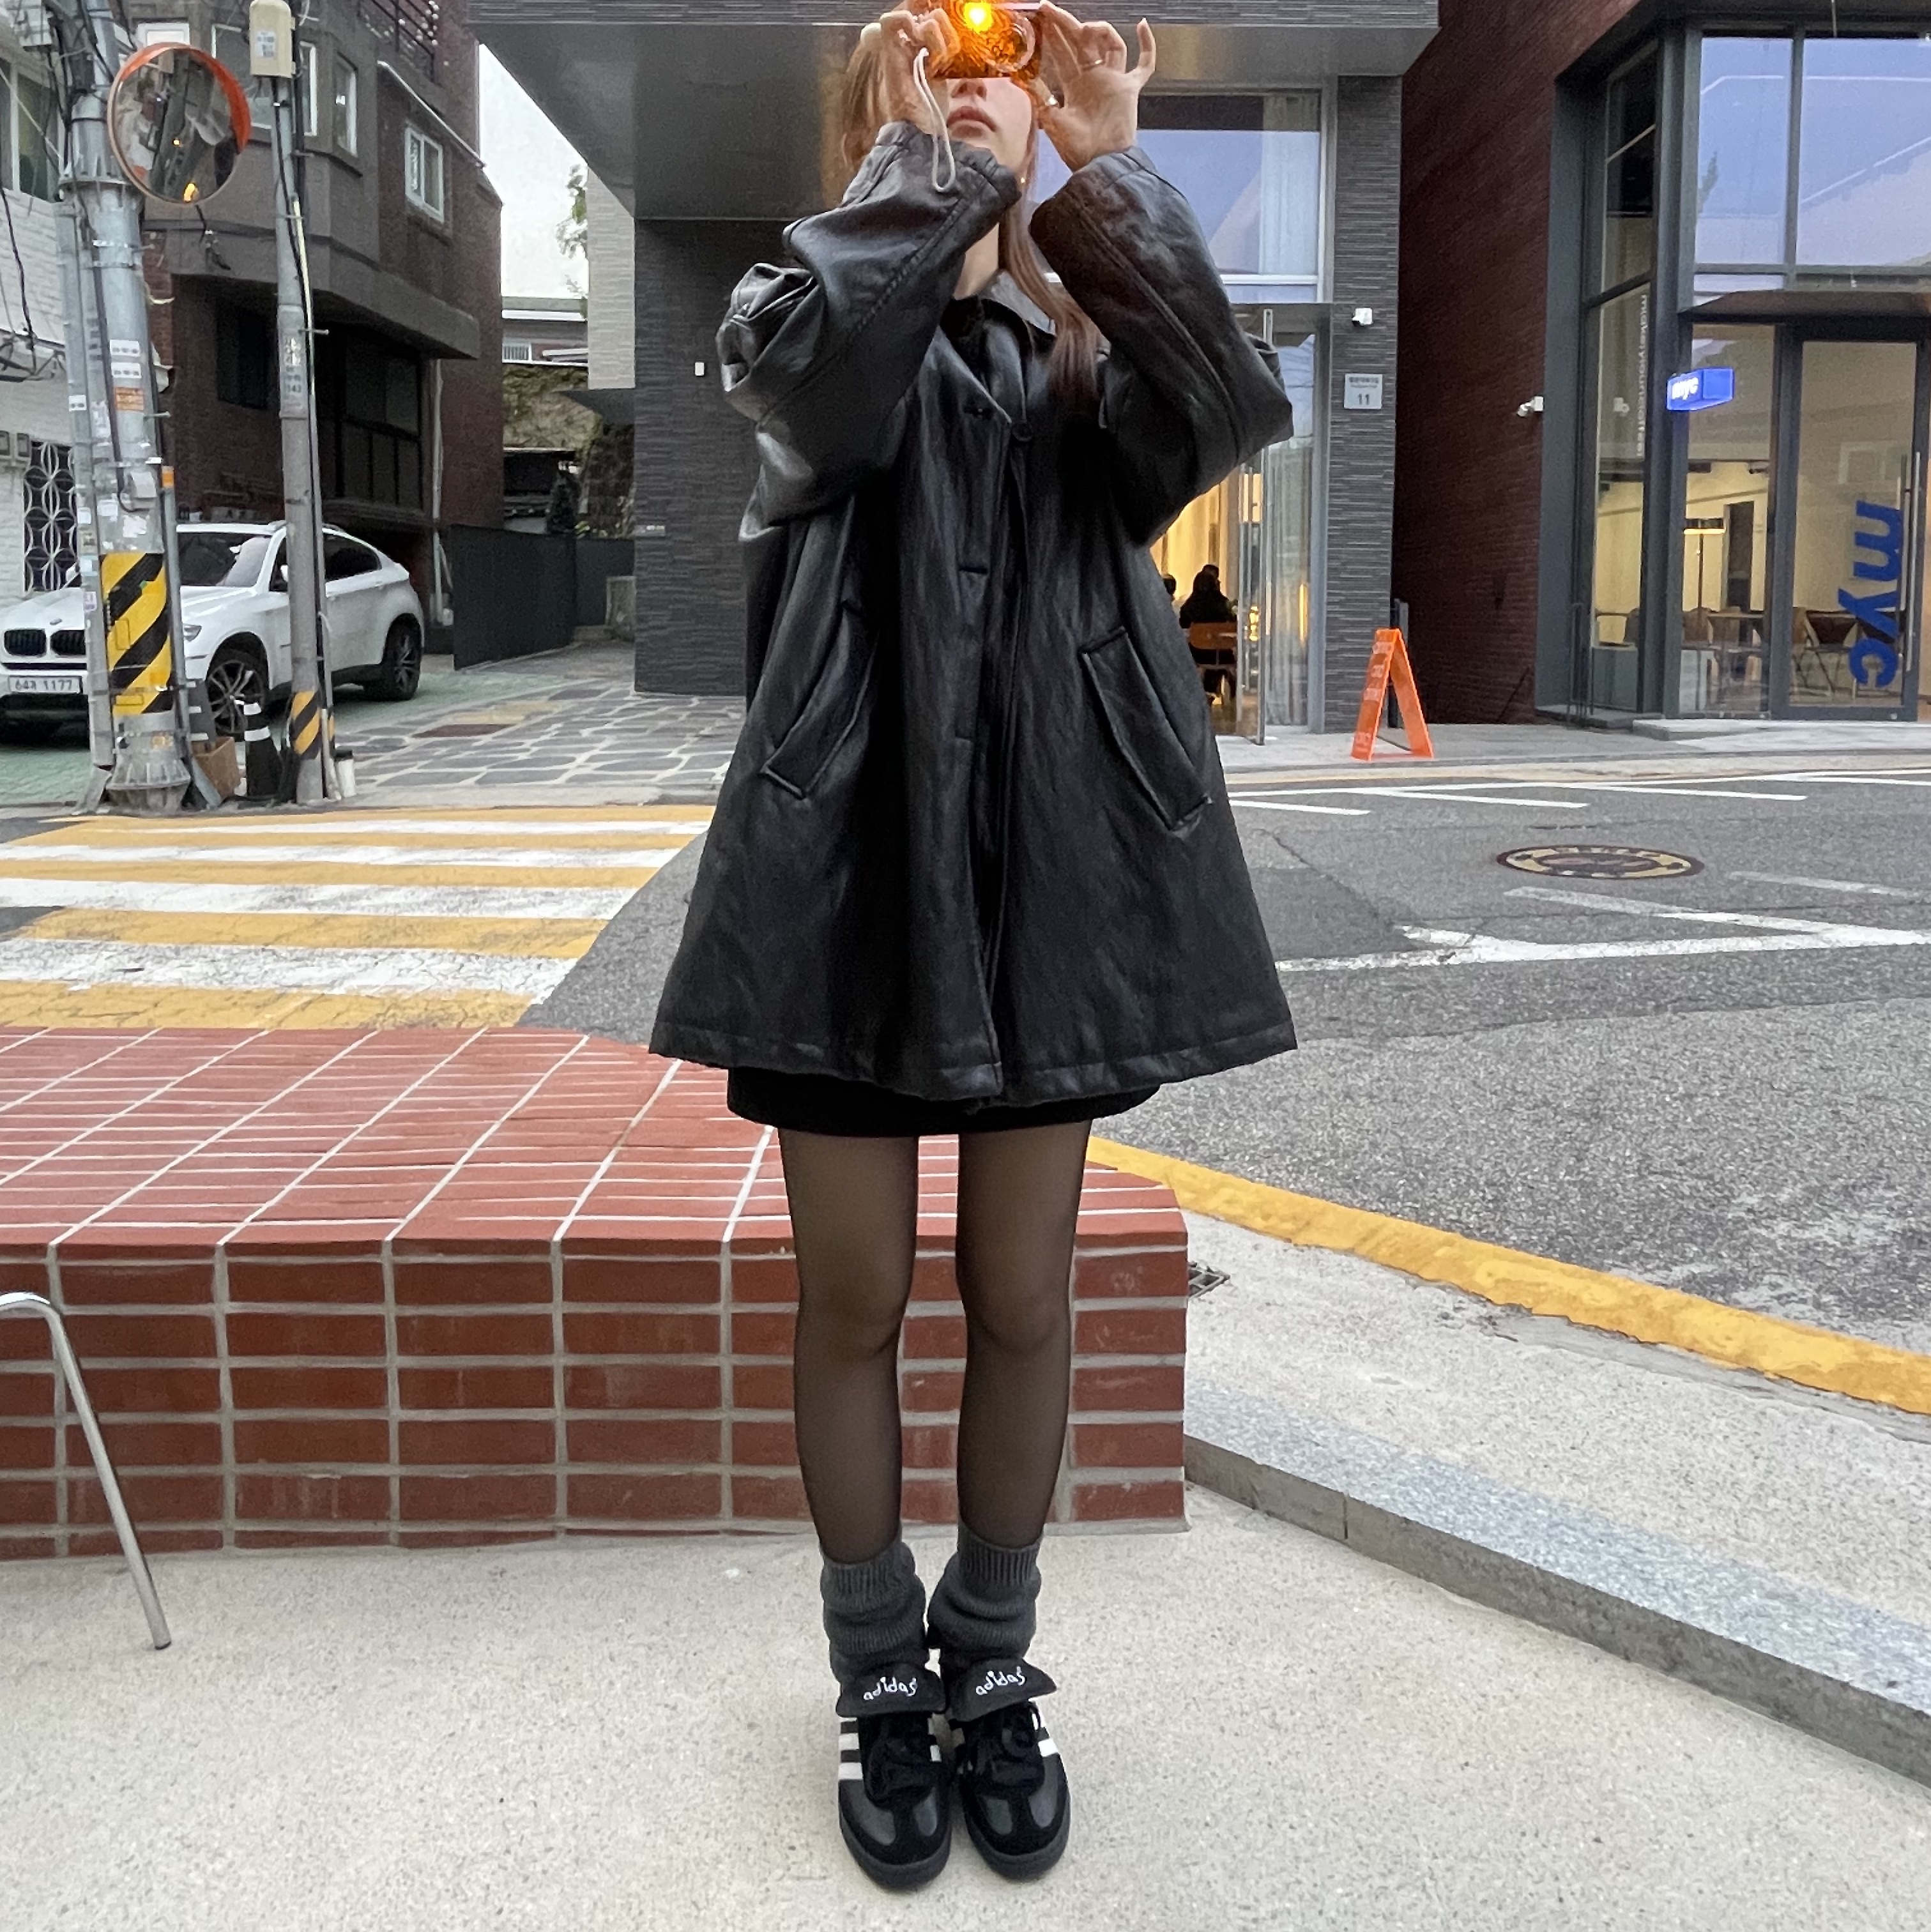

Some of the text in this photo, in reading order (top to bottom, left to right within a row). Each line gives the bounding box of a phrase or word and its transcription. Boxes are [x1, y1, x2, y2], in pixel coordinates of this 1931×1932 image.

[1357, 393, 1370, 406] 11
[1672, 377, 1698, 400] myc
[1838, 500, 1904, 688] myc
[43, 679, 73, 690] 1177
[863, 1676, 919, 1701] adidas
[975, 1665, 1025, 1696] adidas
